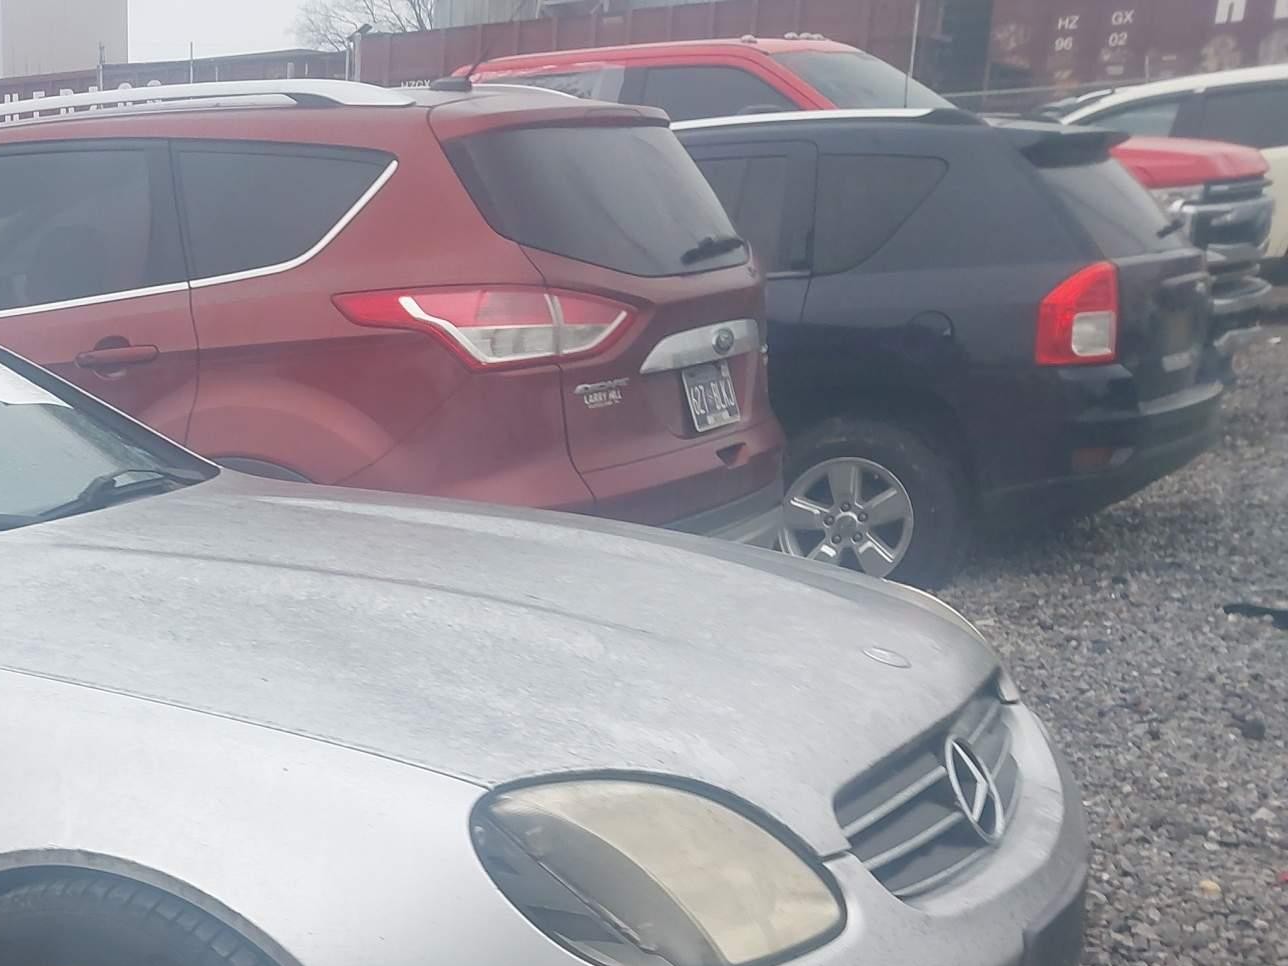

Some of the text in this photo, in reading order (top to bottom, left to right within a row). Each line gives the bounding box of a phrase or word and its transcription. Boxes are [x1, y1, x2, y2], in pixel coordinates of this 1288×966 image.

[1057, 9, 1135, 30] HZ GX
[1054, 32, 1128, 51] 96 02
[690, 384, 710, 416] 627
